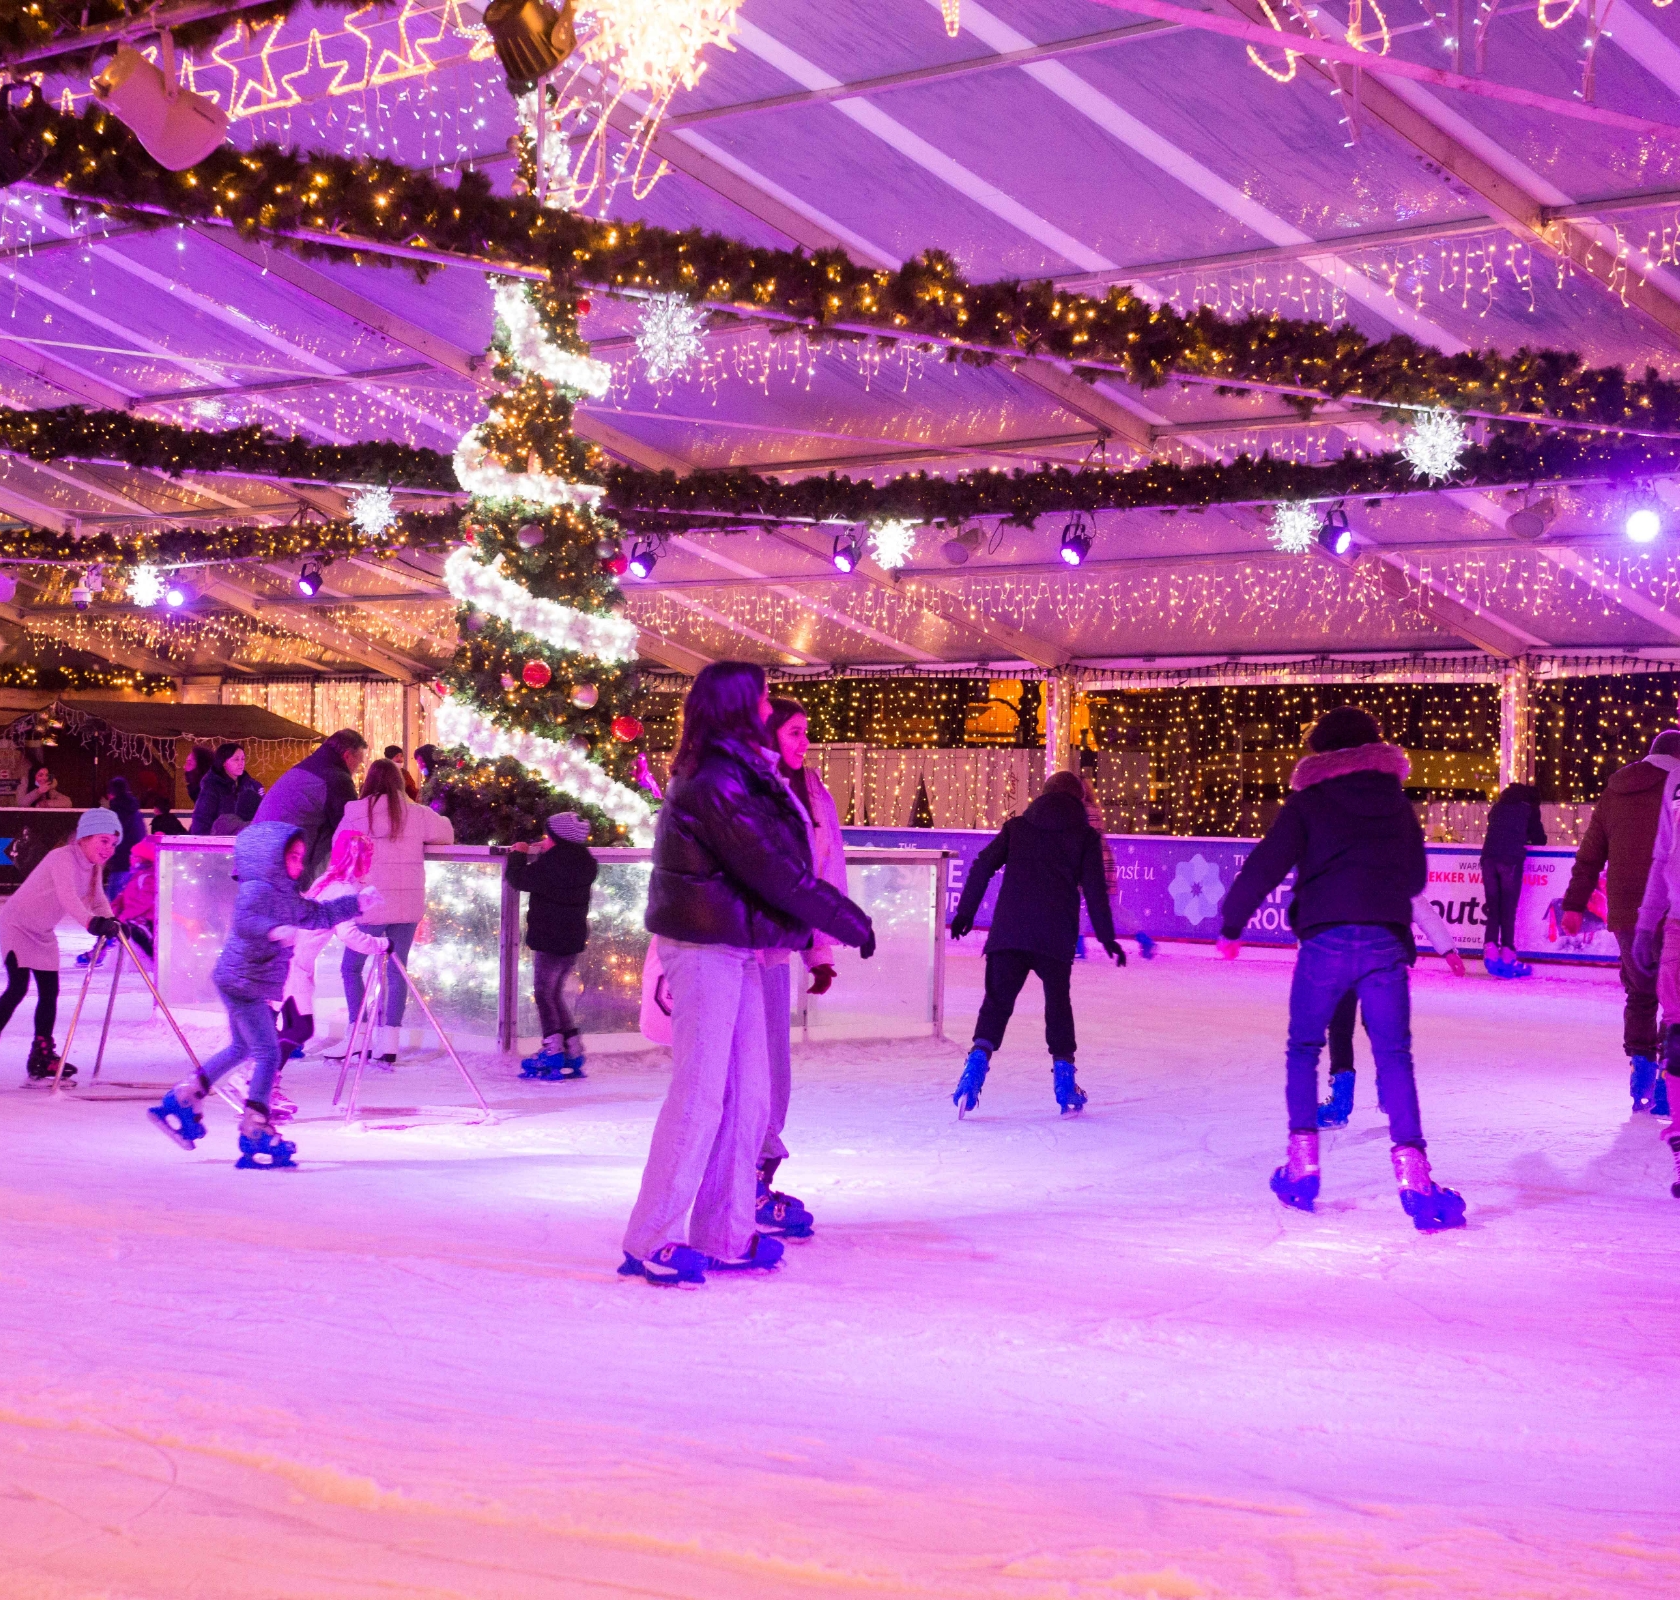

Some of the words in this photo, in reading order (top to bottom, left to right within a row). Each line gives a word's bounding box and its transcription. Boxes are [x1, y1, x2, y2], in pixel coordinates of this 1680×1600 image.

[1233, 854, 1249, 866] TH
[1144, 866, 1156, 880] u
[1428, 871, 1465, 883] EKKER
[1246, 908, 1293, 931] ROU
